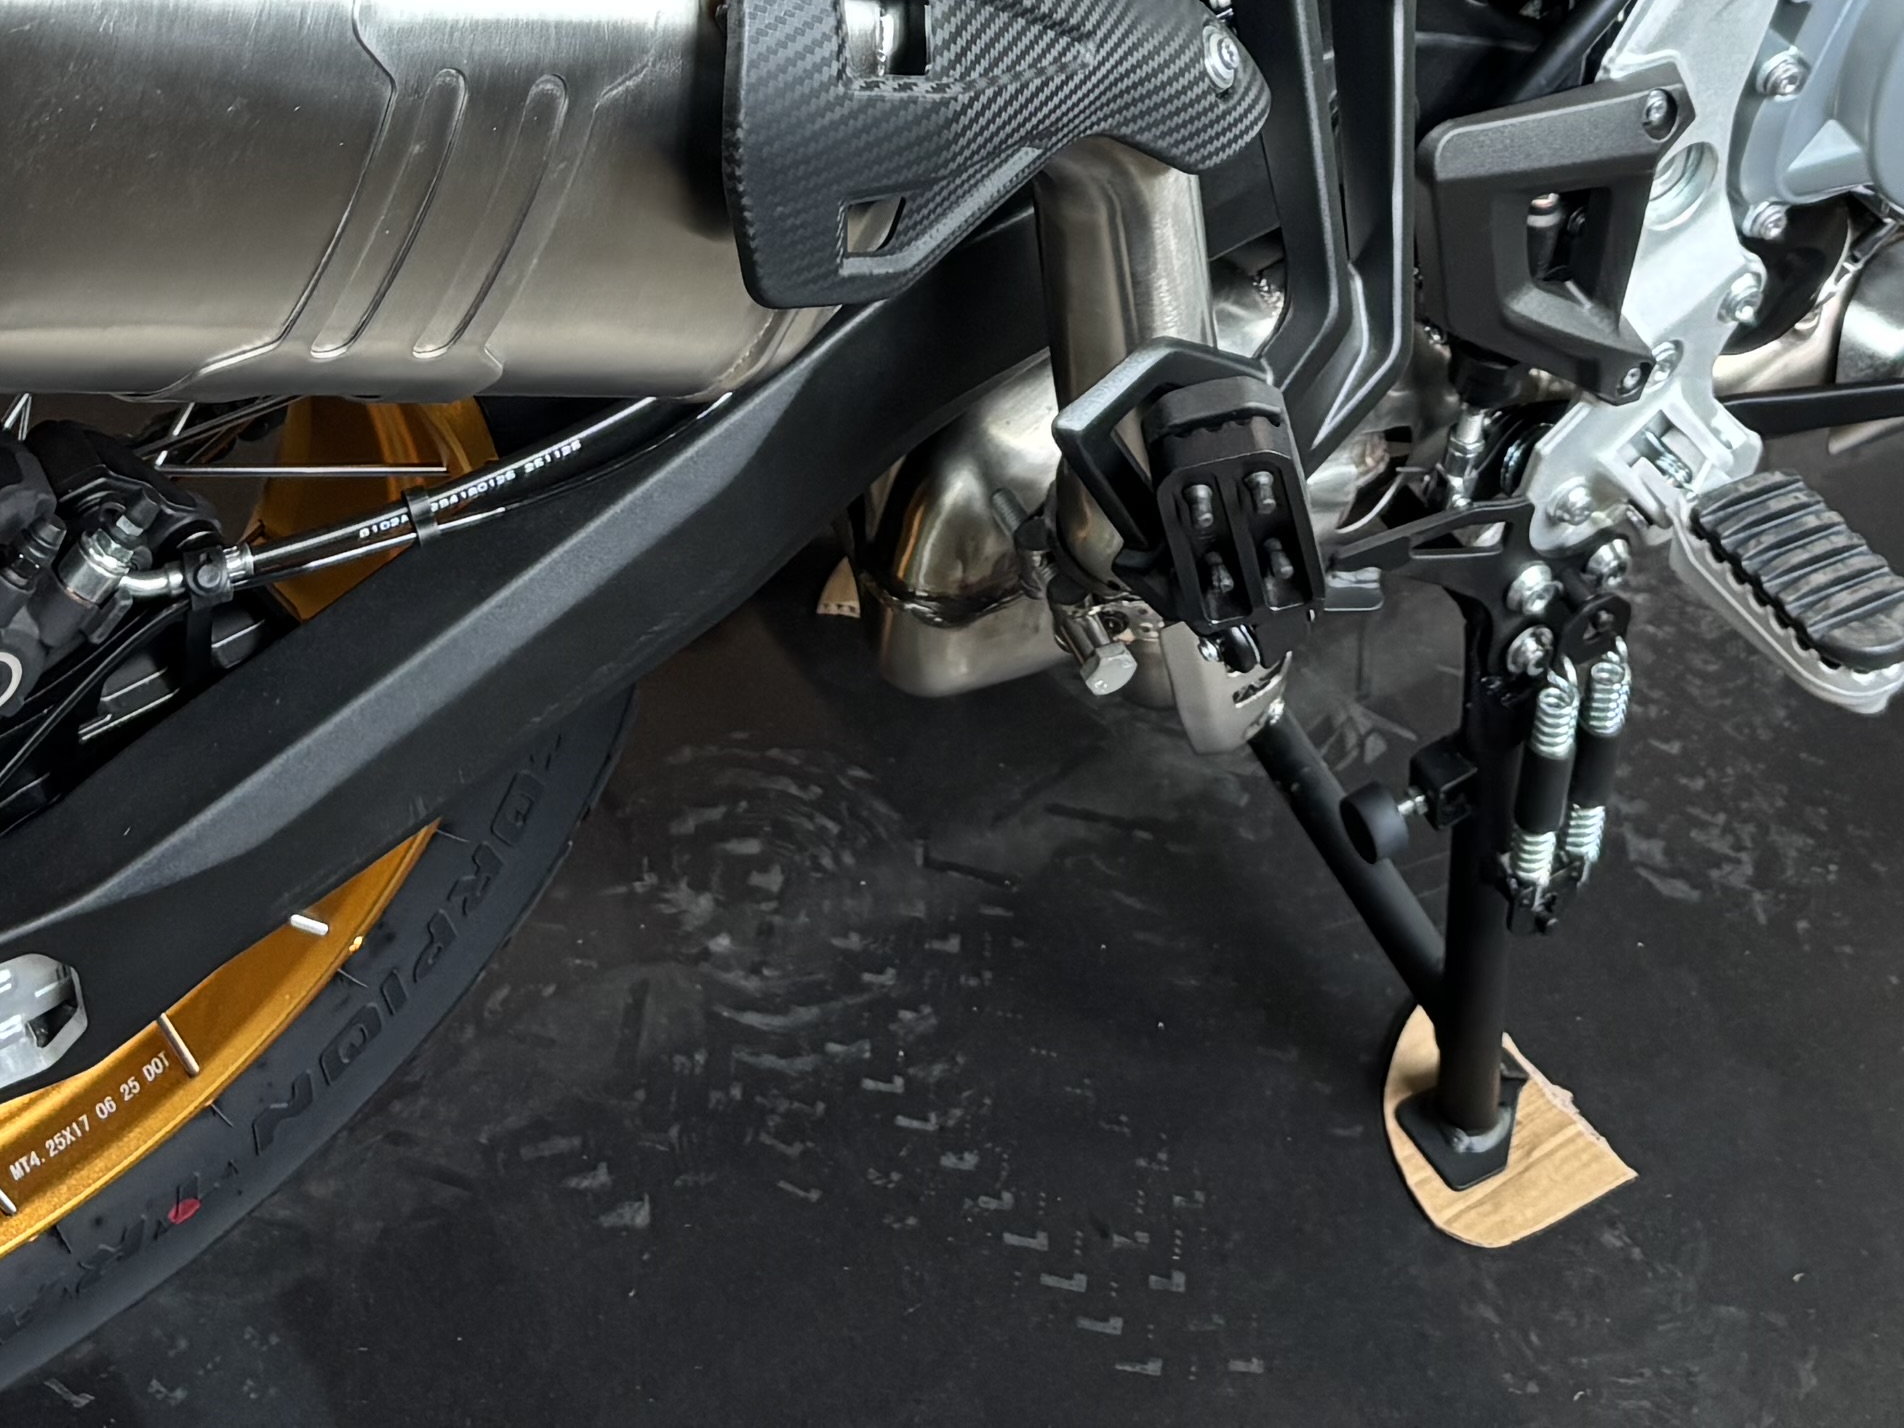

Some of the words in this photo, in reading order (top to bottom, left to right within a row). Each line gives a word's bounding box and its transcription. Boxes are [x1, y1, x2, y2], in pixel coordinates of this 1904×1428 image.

[252, 732, 564, 1157] ORPION
[95, 1095, 117, 1120] 06
[119, 1075, 141, 1102] 25
[142, 1050, 170, 1082] DOT
